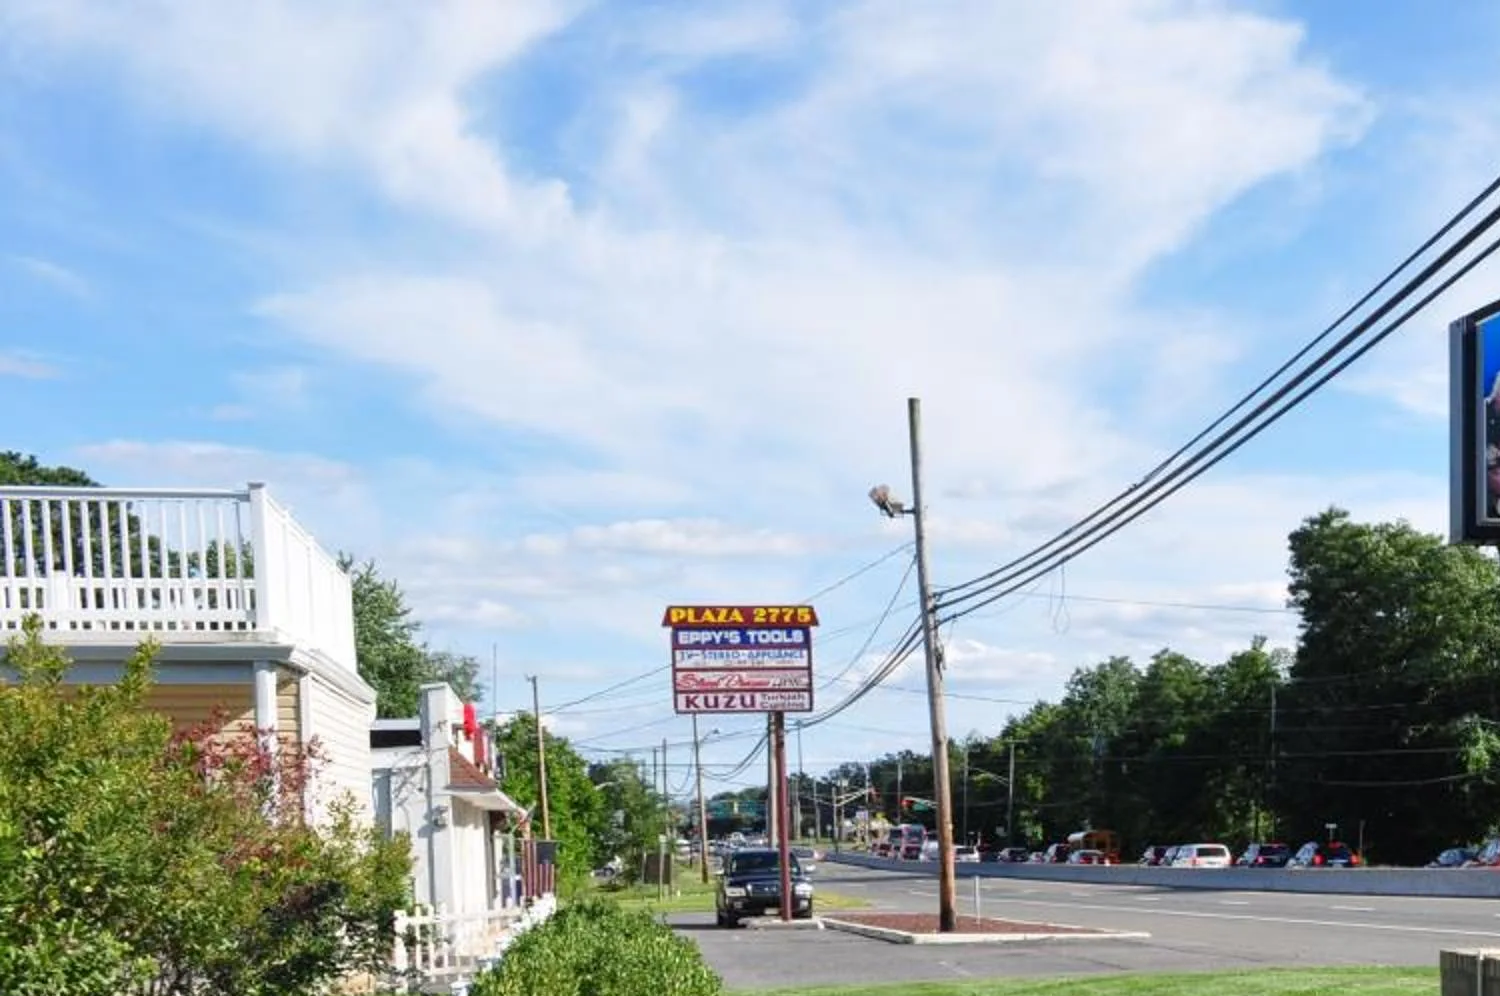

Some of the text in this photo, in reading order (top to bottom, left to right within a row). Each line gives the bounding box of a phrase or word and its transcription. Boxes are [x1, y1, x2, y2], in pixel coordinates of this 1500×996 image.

[670, 607, 811, 623] PLAZA 2775
[678, 629, 804, 645] EPPY'S TOOLS
[686, 694, 756, 709] KUZU
